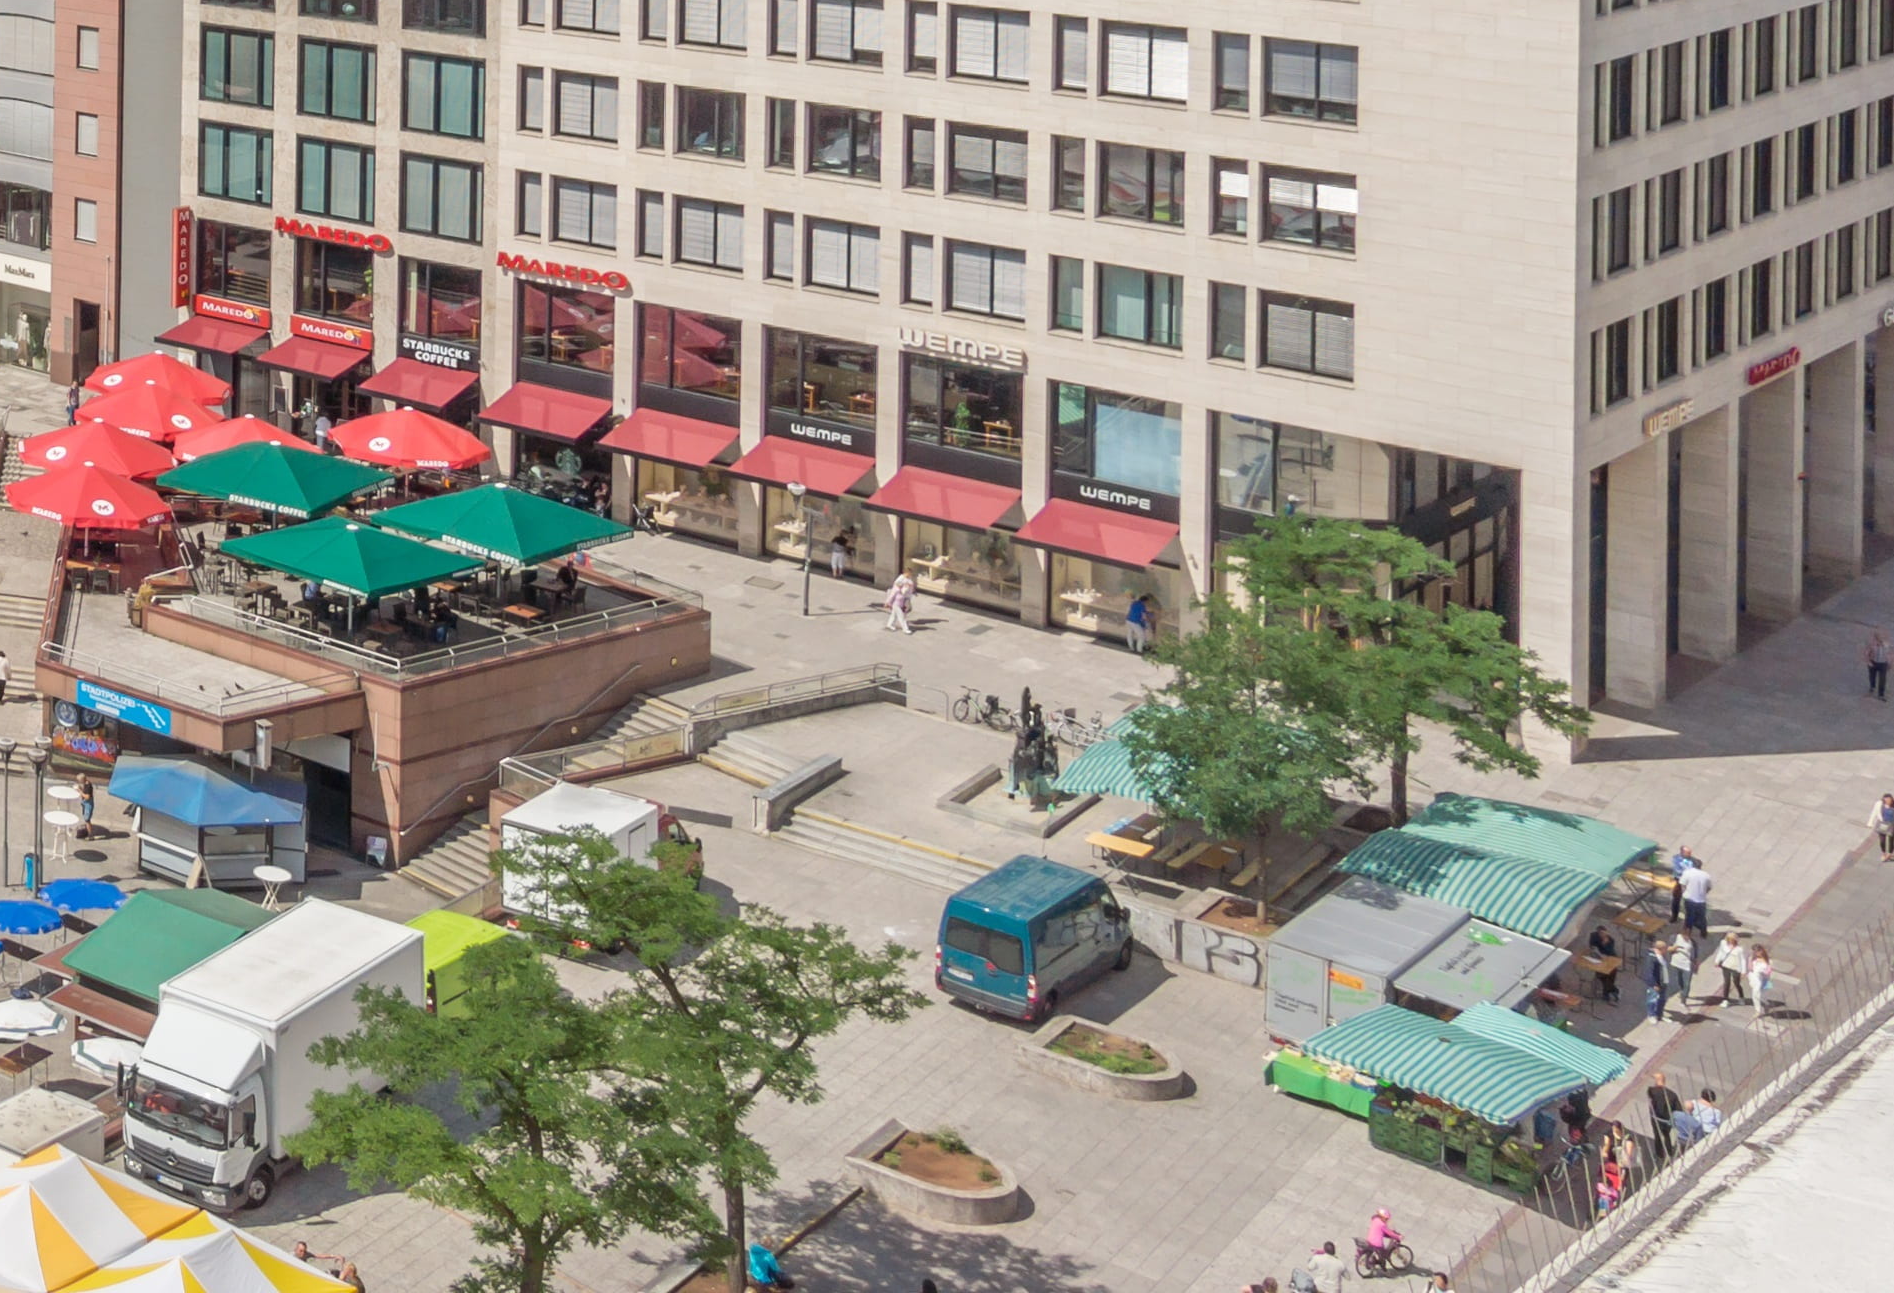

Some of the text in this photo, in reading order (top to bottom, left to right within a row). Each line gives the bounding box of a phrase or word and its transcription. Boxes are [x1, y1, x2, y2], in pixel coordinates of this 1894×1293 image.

[274, 215, 391, 253] MAREDO
[177, 210, 190, 286] MAREDO
[496, 251, 628, 293] MAREDO
[202, 301, 254, 320] MAREDO
[300, 322, 360, 342] MAREDO
[403, 337, 471, 361] STARBUCKS
[896, 324, 1024, 367] WEMPE
[414, 350, 458, 369] COFFEE
[789, 423, 853, 446] WEMPE
[228, 493, 277, 512] STARBUCKS
[1079, 484, 1152, 511] WEMPE
[441, 534, 489, 557] STARBUCKS
